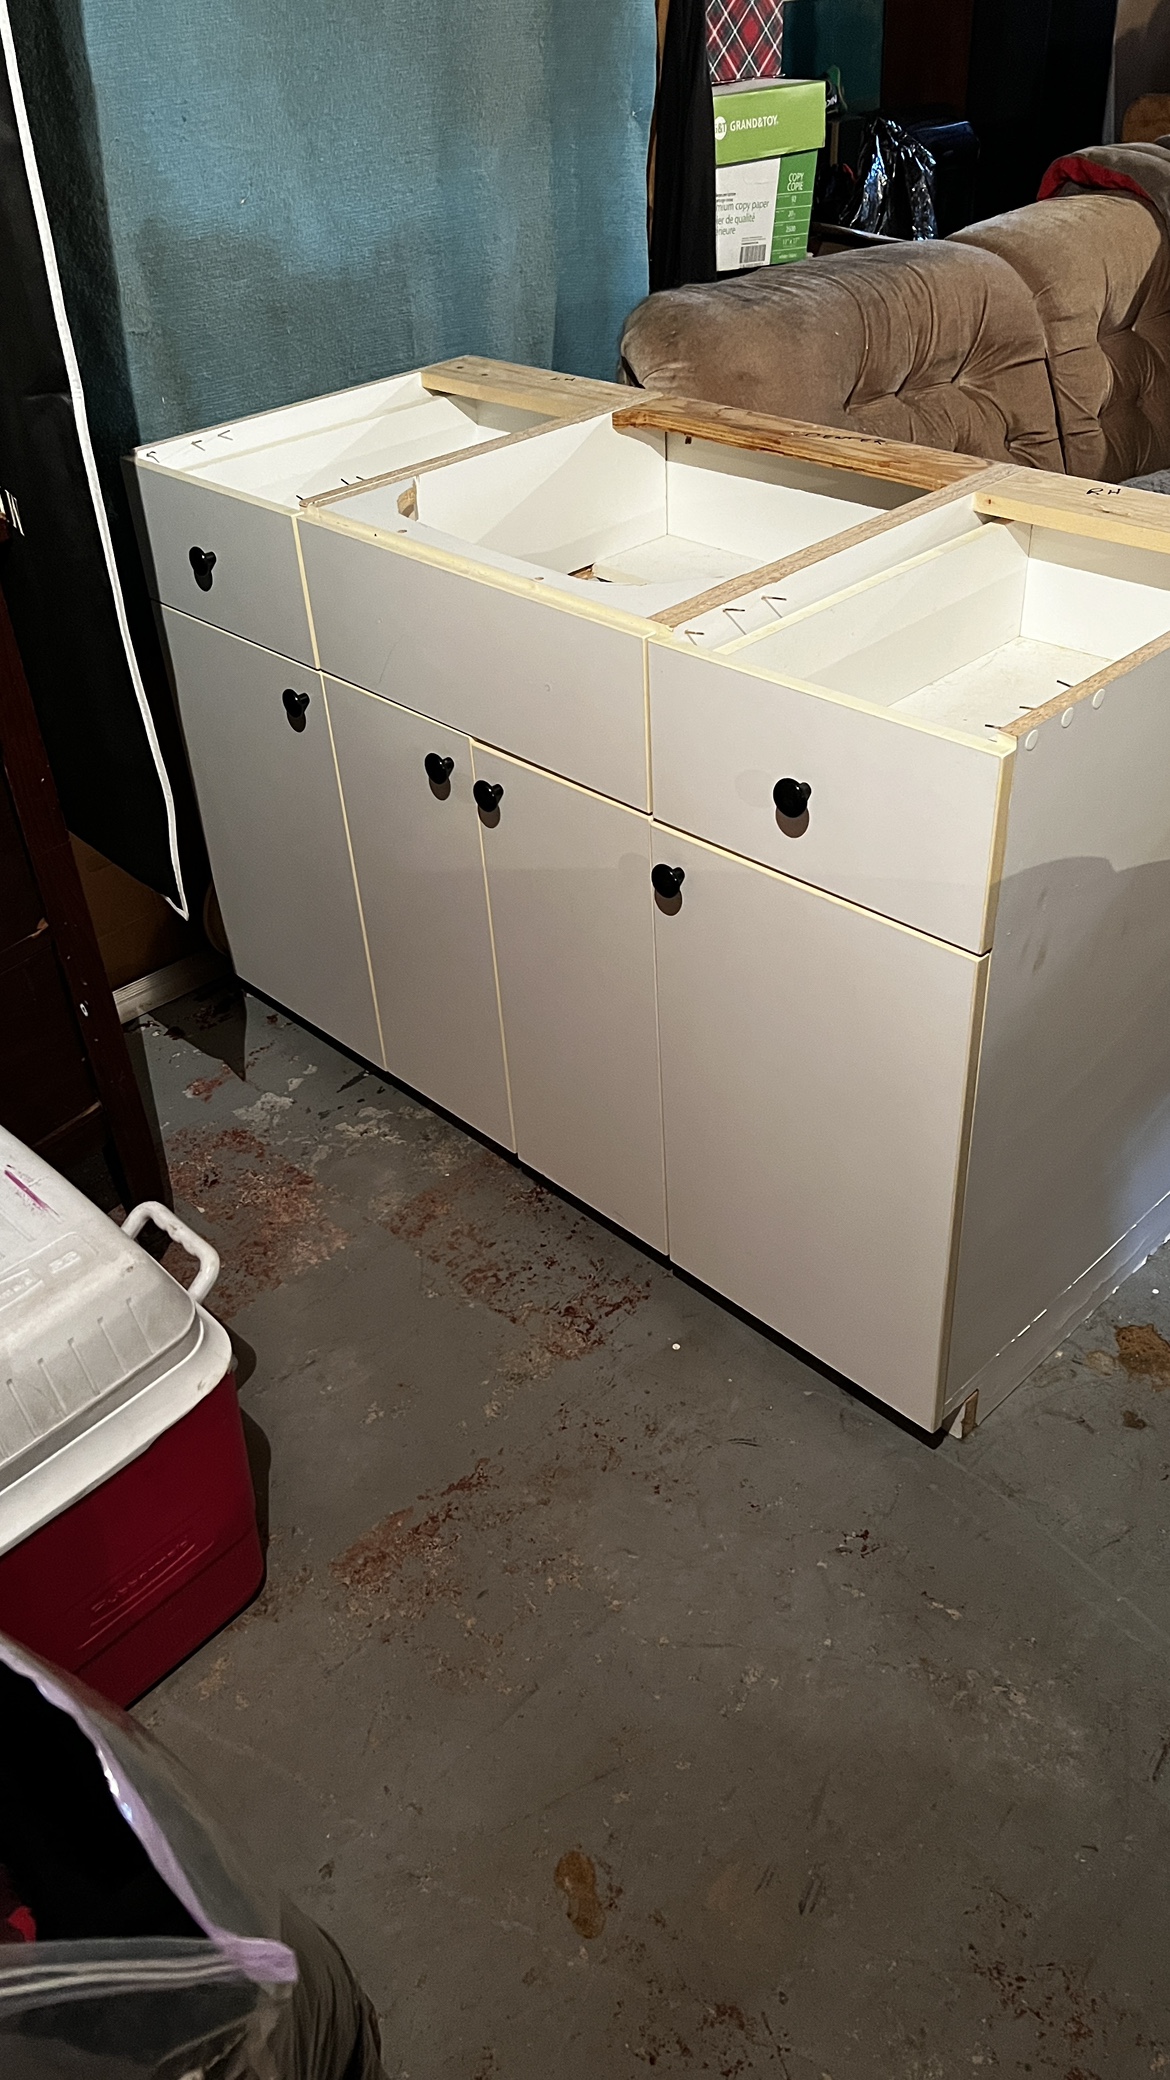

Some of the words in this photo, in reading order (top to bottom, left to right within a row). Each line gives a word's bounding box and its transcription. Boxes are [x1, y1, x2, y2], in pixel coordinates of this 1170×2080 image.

[729, 114, 778, 131] GRAND&TOY
[788, 172, 804, 182] COPY
[787, 181, 804, 191] COPIE
[735, 202, 750, 212] copy
[752, 200, 770, 211] paper
[725, 214, 734, 224] de
[735, 212, 755, 225] qualité
[1085, 487, 1122, 496] RH
